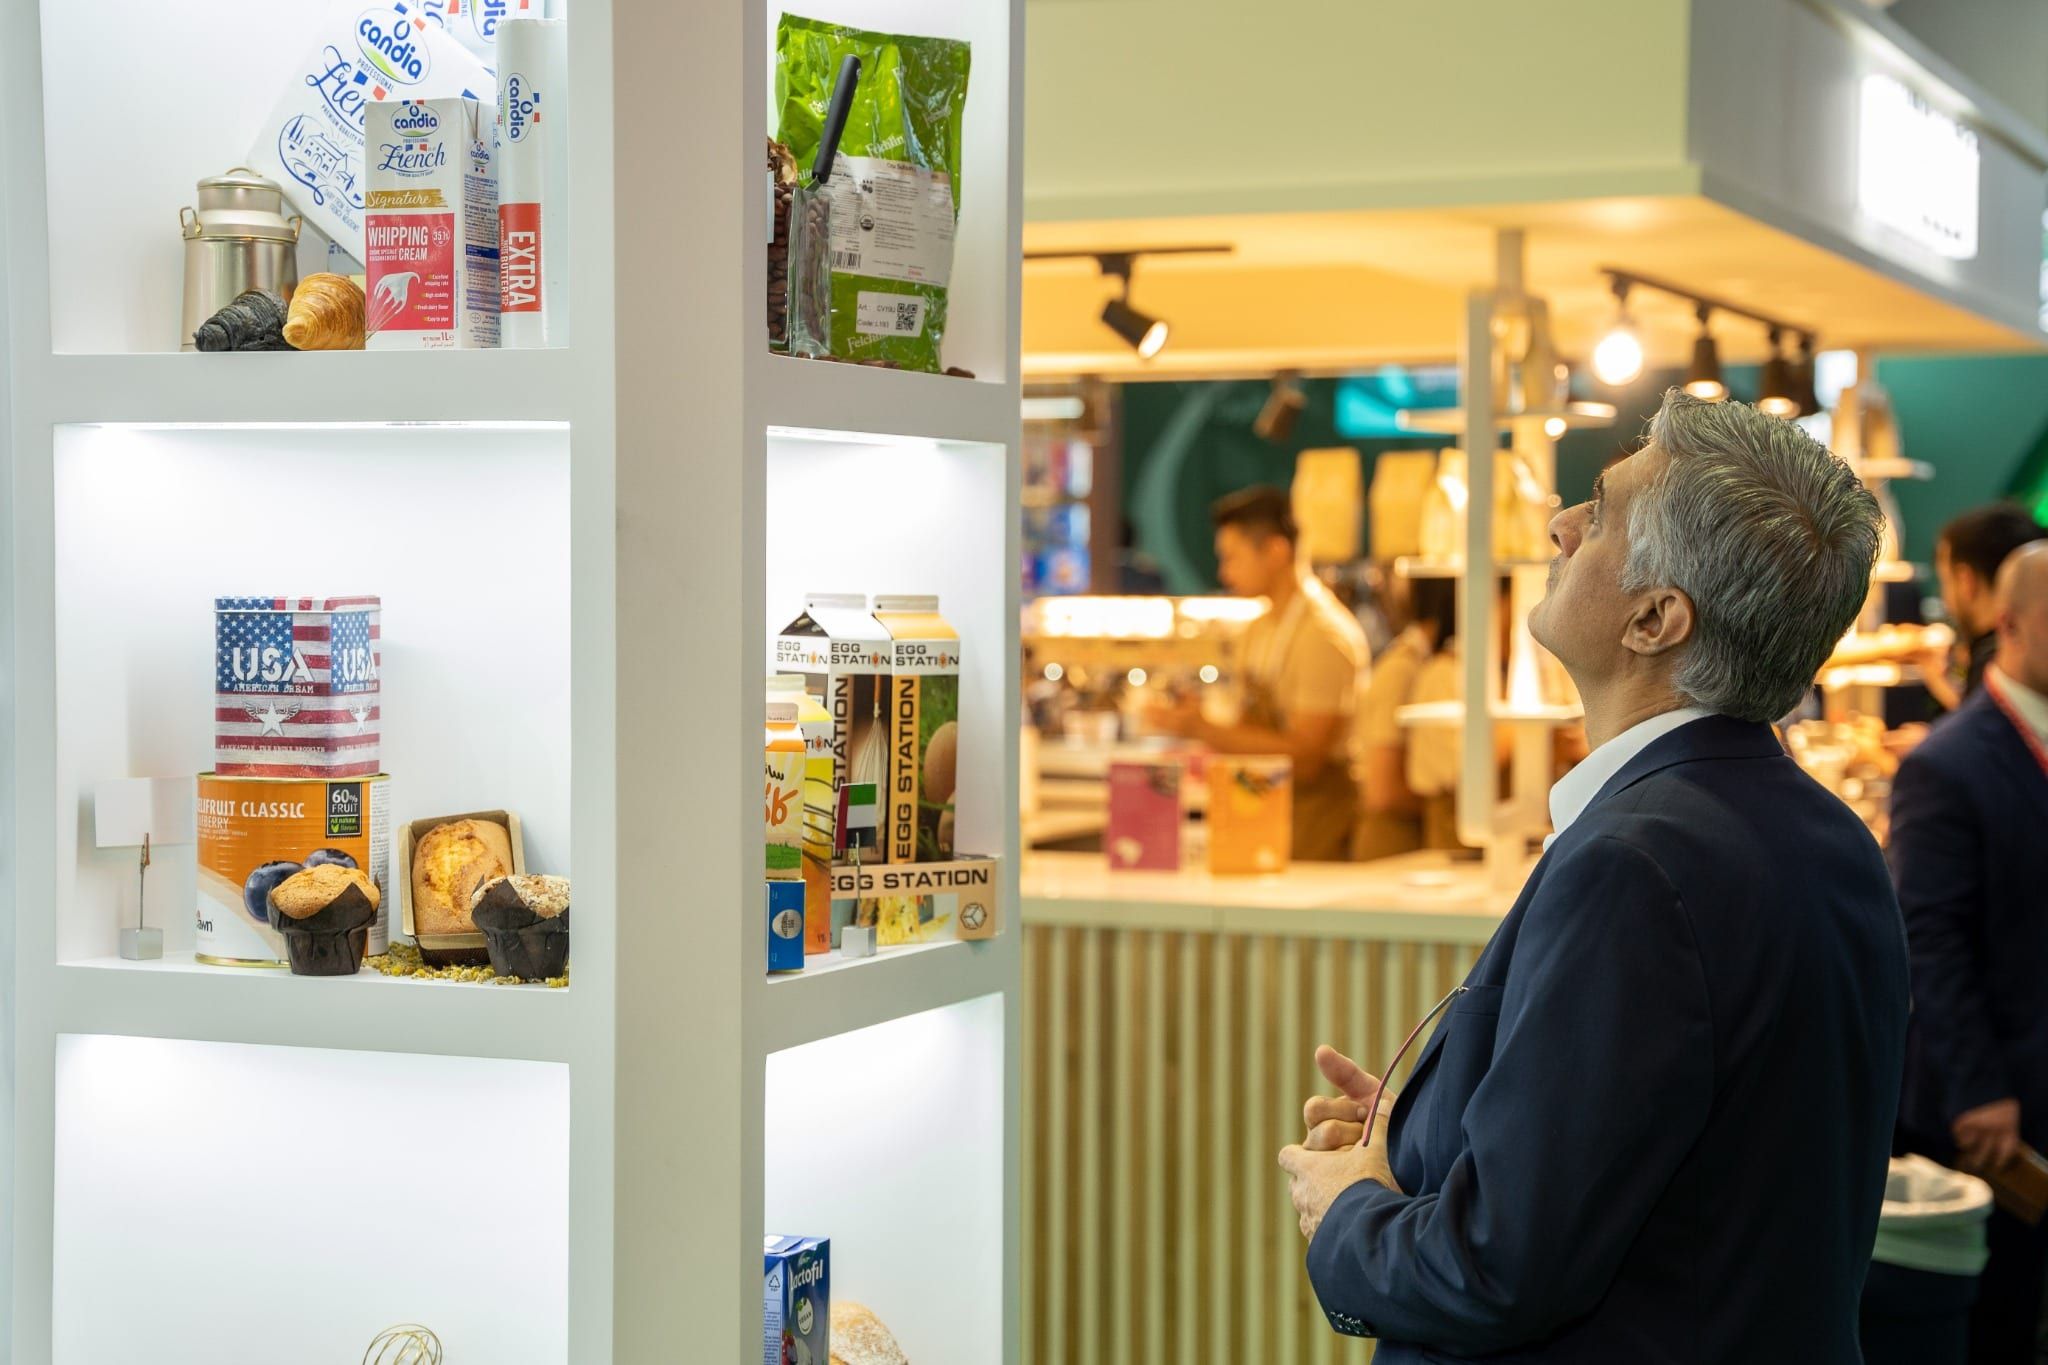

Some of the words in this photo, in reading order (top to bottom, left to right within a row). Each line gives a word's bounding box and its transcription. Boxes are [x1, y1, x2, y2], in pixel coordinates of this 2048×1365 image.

[484, 0, 505, 36] dia
[359, 18, 422, 80] candia
[356, 57, 394, 94] PROFESSIONAL
[509, 77, 524, 139] candia
[394, 113, 437, 129] candia
[377, 142, 447, 172] French
[367, 190, 430, 208] Signature
[368, 226, 429, 246] WHIPPING
[398, 248, 428, 261] CREAM
[501, 255, 509, 293] BUTTER
[508, 231, 536, 306] EXTRA
[777, 640, 801, 651] EGG
[831, 643, 861, 653] EGG
[896, 645, 927, 655] EGG
[232, 646, 316, 682] USA
[342, 647, 378, 682] USA
[233, 684, 279, 693] AMERICAN
[283, 684, 314, 694] DREAM
[833, 677, 848, 793] STATION
[897, 679, 914, 792] STATION
[332, 789, 358, 804] 60%
[241, 801, 305, 818] CLASSIC
[332, 803, 358, 813] FRUIT
[897, 803, 912, 860] EGG
[883, 868, 988, 890] STATION
[196, 919, 213, 933] awn
